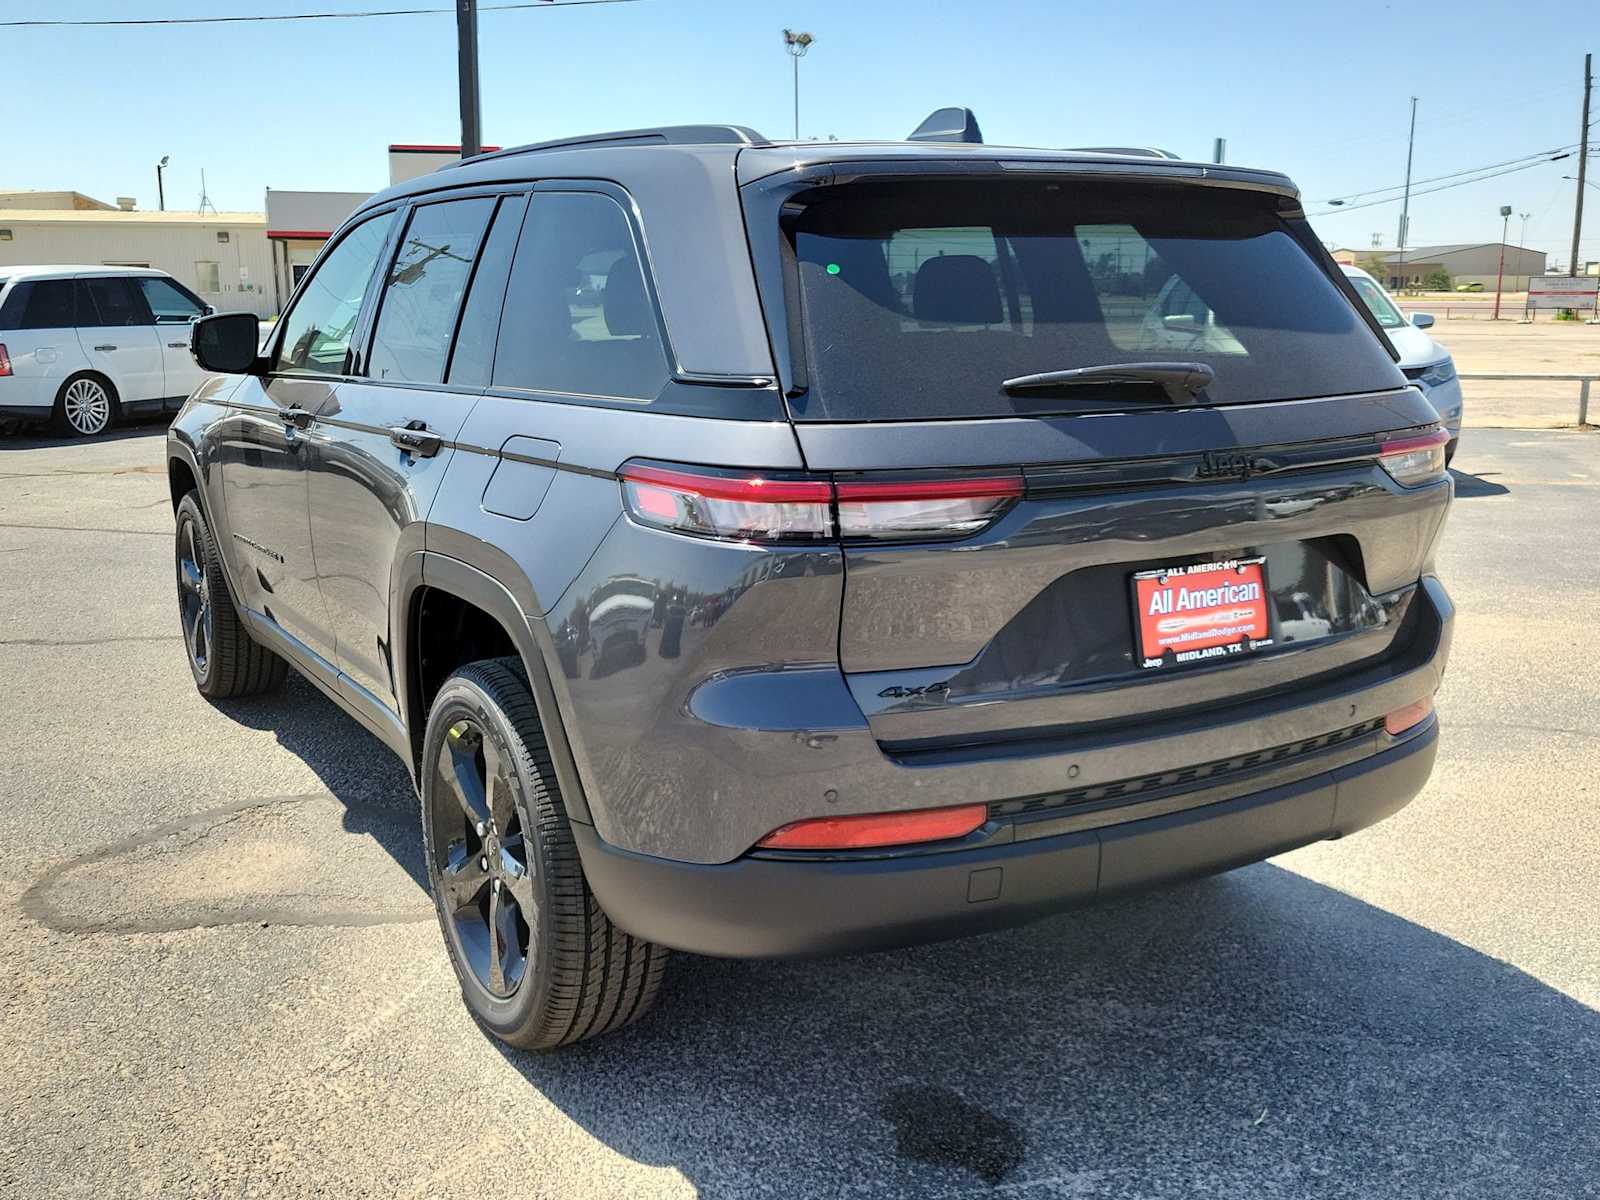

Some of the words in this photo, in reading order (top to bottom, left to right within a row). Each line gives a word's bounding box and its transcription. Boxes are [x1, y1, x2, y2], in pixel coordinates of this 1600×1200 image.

[1167, 566, 1186, 577] ALL
[1149, 588, 1172, 615] All
[1176, 581, 1260, 611] American
[1228, 643, 1242, 653] TX
[1143, 657, 1163, 668] Jeep
[877, 682, 950, 697] 4x4
